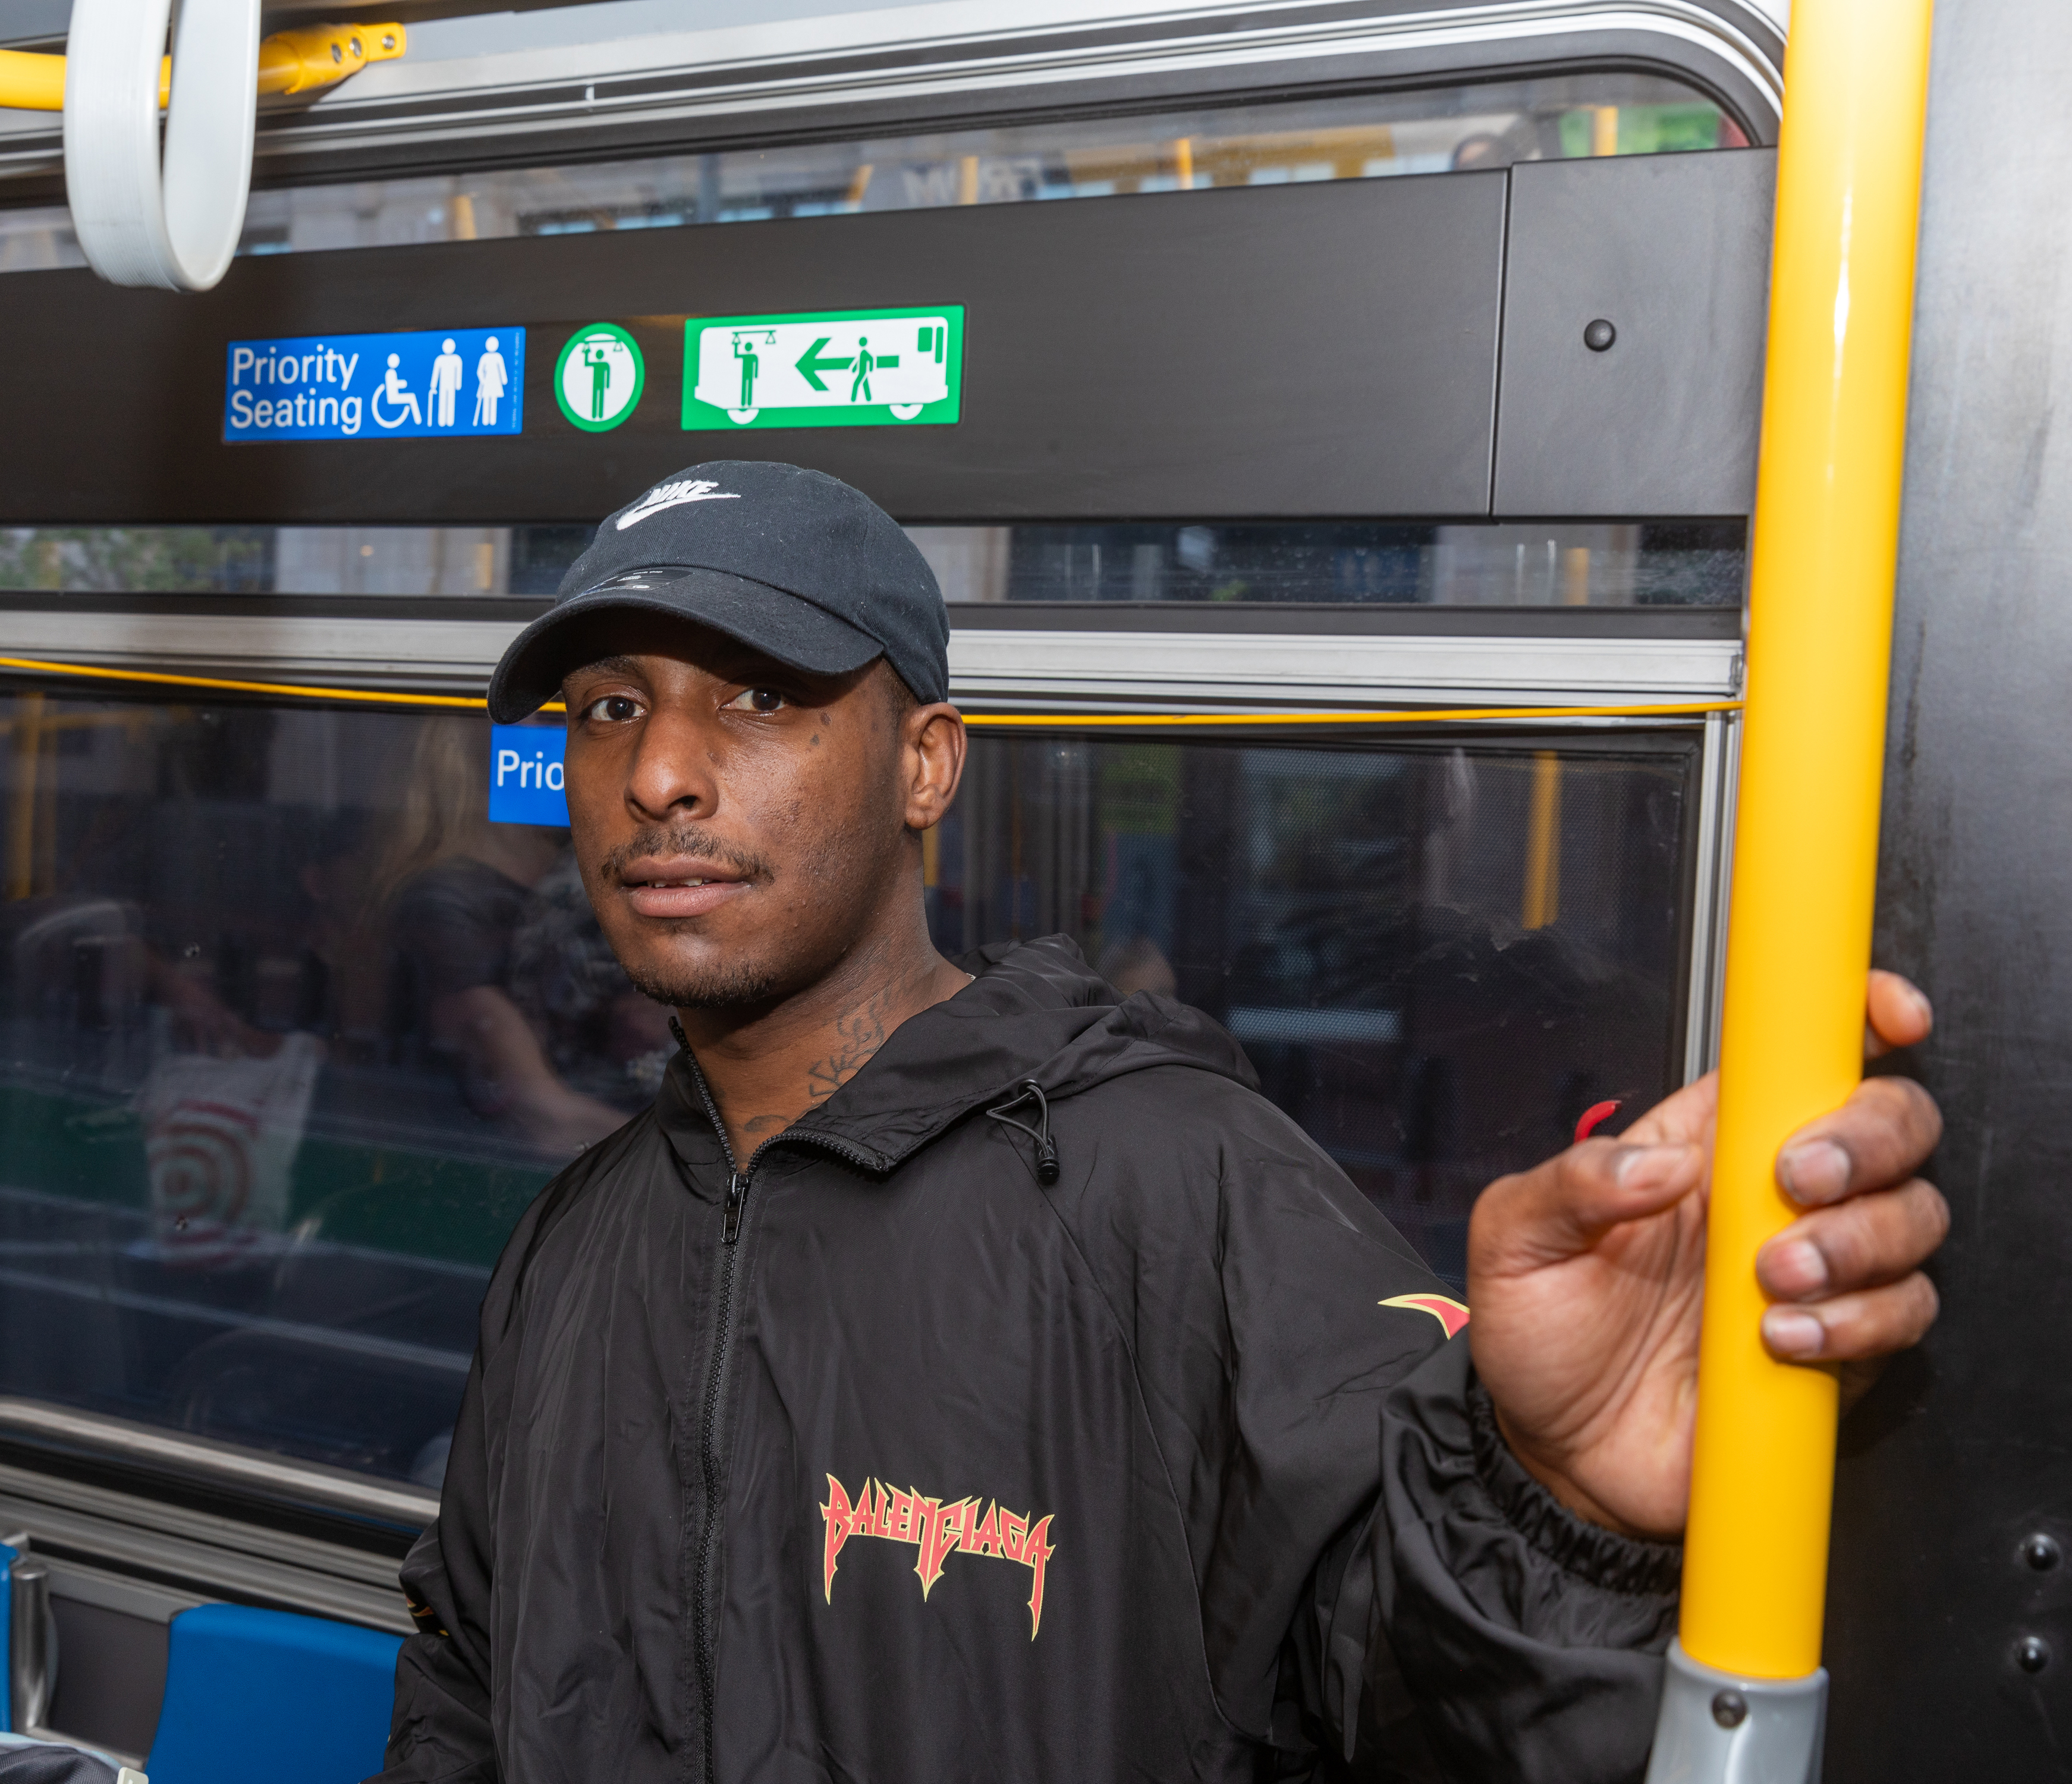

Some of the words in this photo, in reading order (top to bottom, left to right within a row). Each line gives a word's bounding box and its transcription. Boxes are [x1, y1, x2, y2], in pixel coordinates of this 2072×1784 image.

[232, 343, 360, 391] Priority
[230, 387, 362, 435] Seating
[641, 479, 719, 506] NIKE
[819, 1472, 1057, 1642] BALENCIAGA
